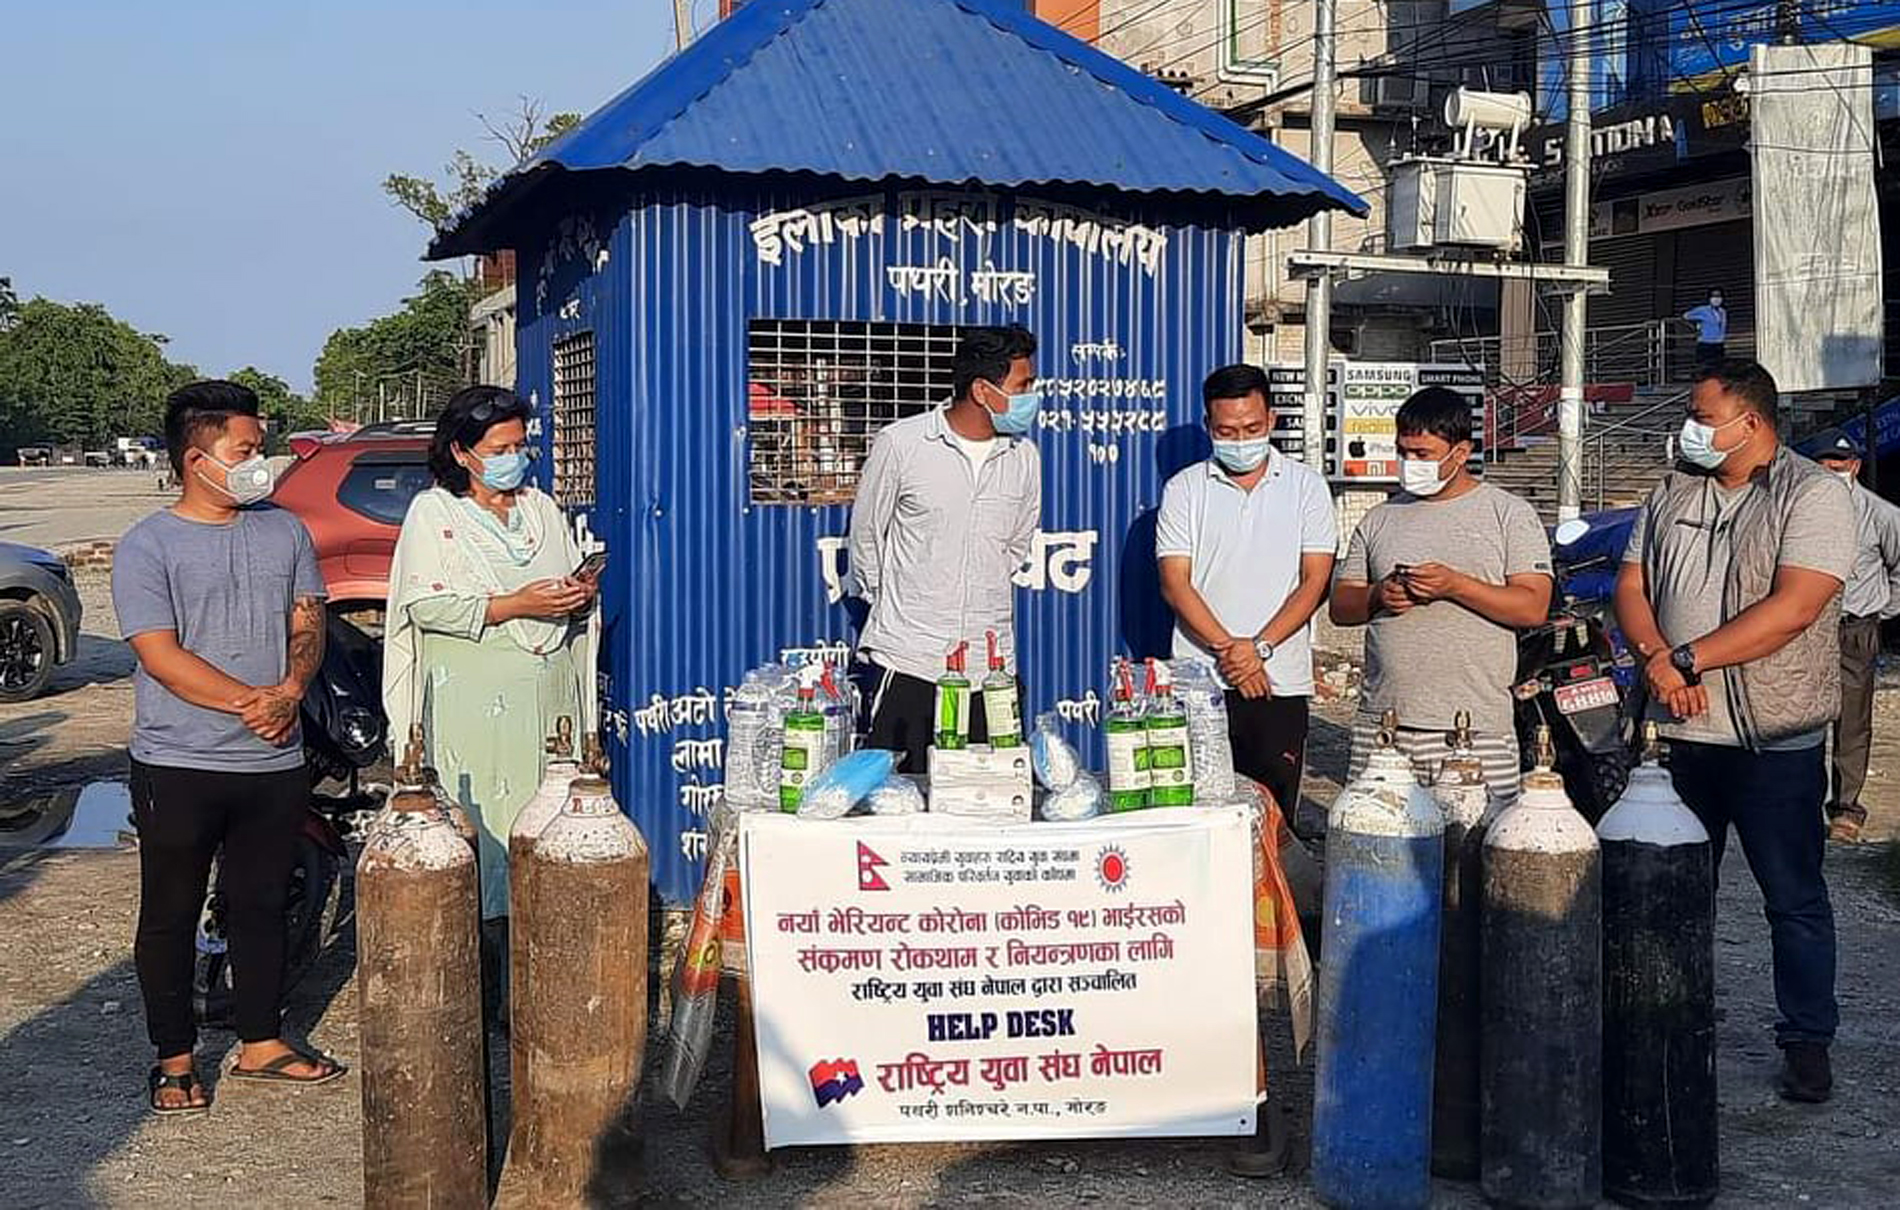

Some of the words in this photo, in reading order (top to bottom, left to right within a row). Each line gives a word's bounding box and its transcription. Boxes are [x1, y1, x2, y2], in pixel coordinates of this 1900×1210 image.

[1347, 369, 1411, 381] SAMSUNG
[1421, 373, 1451, 384] SMART
[1088, 443, 1119, 464] १००
[829, 906, 910, 937] भेरियन्ट
[919, 904, 987, 935] कोरोना
[1102, 899, 1186, 928] भाईरसको
[797, 941, 881, 973] संक्रमण
[891, 940, 977, 972] रोकथाम
[985, 945, 999, 970] र
[1007, 938, 1119, 968] नियन्त्रणका
[1128, 932, 1174, 961] लागि
[852, 979, 907, 1005] राष्ट्रिय
[912, 981, 943, 1003] युवा
[950, 976, 976, 999] संघ
[981, 974, 1026, 998] नेपाल
[1031, 975, 1062, 998] द्वारा
[927, 1012, 995, 1042] HELP
[1007, 1008, 1076, 1038] DESK
[876, 1051, 970, 1095] राष्ट्रिय
[980, 1055, 1028, 1090] युवा
[1038, 1049, 1081, 1082] संघ
[1089, 1044, 1163, 1077] नेपाल
